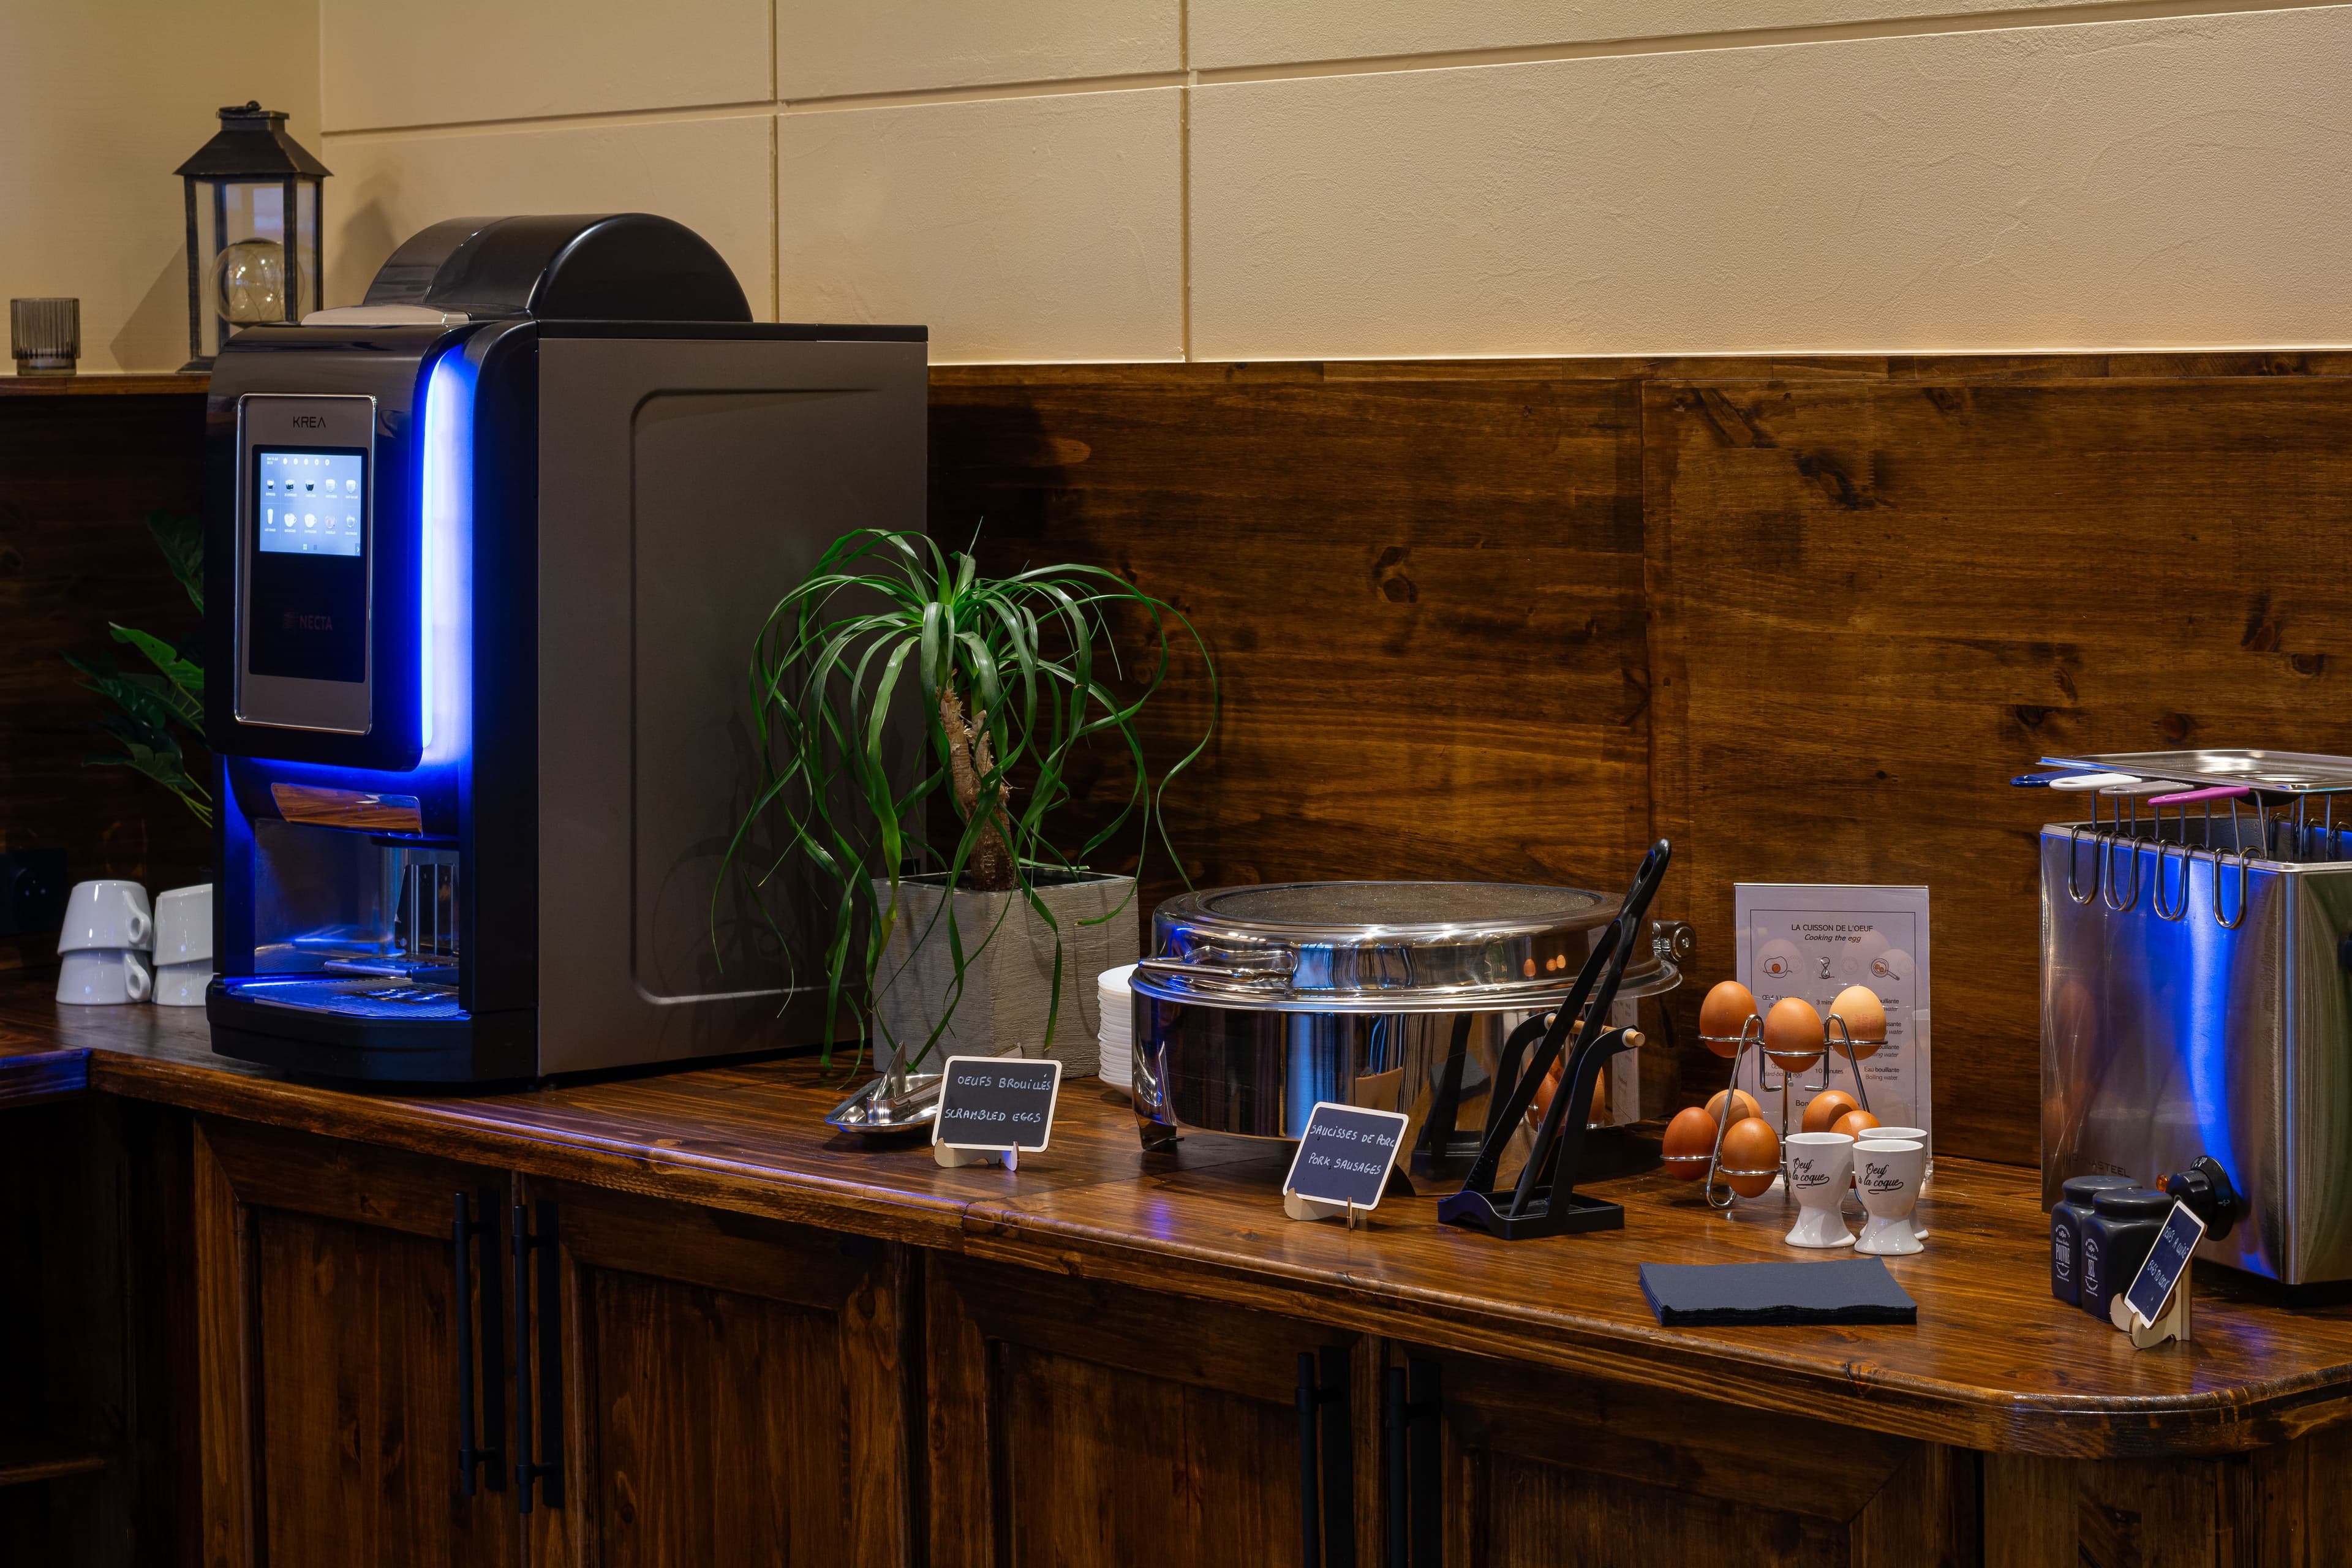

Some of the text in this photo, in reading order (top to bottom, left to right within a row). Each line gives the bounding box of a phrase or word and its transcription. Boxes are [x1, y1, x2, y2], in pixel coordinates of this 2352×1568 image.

[292, 416, 326, 428] KREA
[299, 615, 333, 630] NECTA
[1804, 933, 1833, 943] Cooking
[957, 1076, 992, 1087] OEUFS
[944, 1107, 1041, 1123] SCRAMBLED EGGS
[1361, 1134, 1374, 1144] DE
[1376, 1134, 1395, 1147] PORC
[1308, 1152, 1381, 1175] PORK SAUSAGES
[1793, 1157, 1814, 1173] Oeuf
[1865, 1163, 1890, 1179] Oeuf
[1792, 1170, 1799, 1182] la
[1800, 1173, 1830, 1186] coque
[1863, 1175, 1872, 1187] la
[1873, 1178, 1903, 1192] coque
[2056, 1243, 2070, 1265] POIVRE
